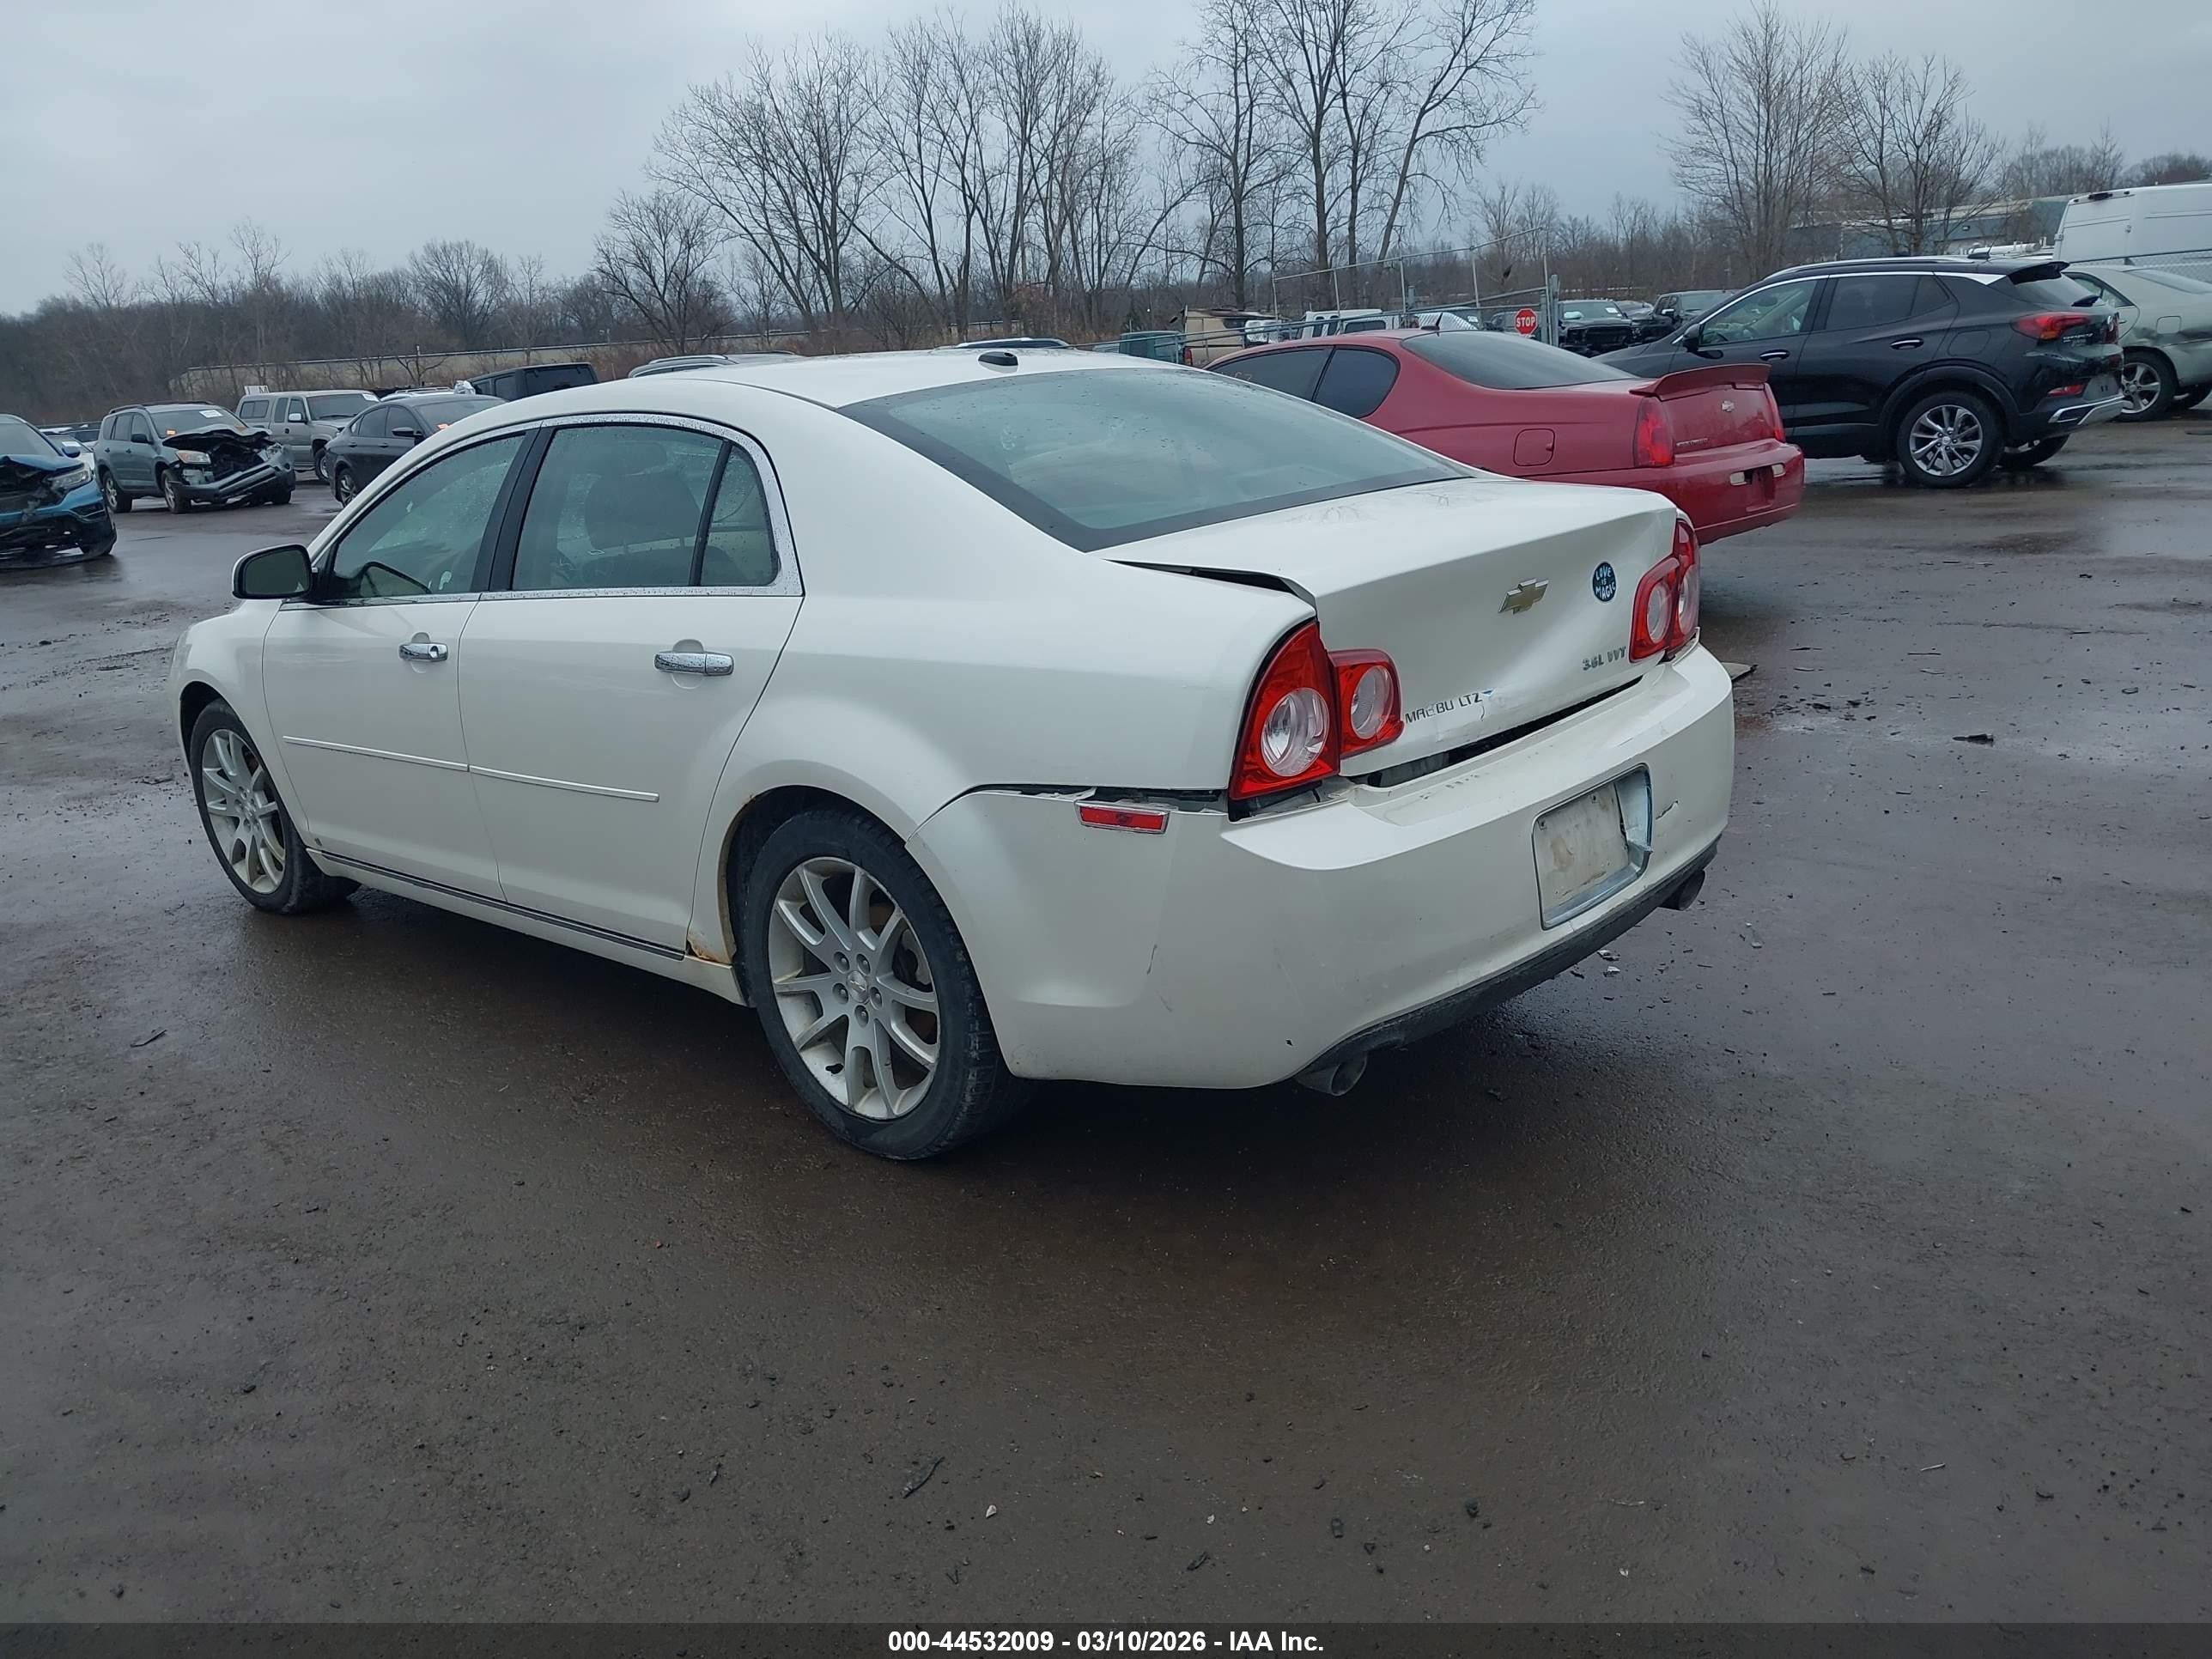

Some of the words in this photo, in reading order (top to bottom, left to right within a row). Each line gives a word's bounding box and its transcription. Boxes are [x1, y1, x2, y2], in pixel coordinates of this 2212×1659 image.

[1516, 316, 1535, 327] STOP
[1595, 565, 1612, 580] LOVE
[1595, 581, 1616, 599] MAGIC
[1458, 692, 1483, 708] LTZ
